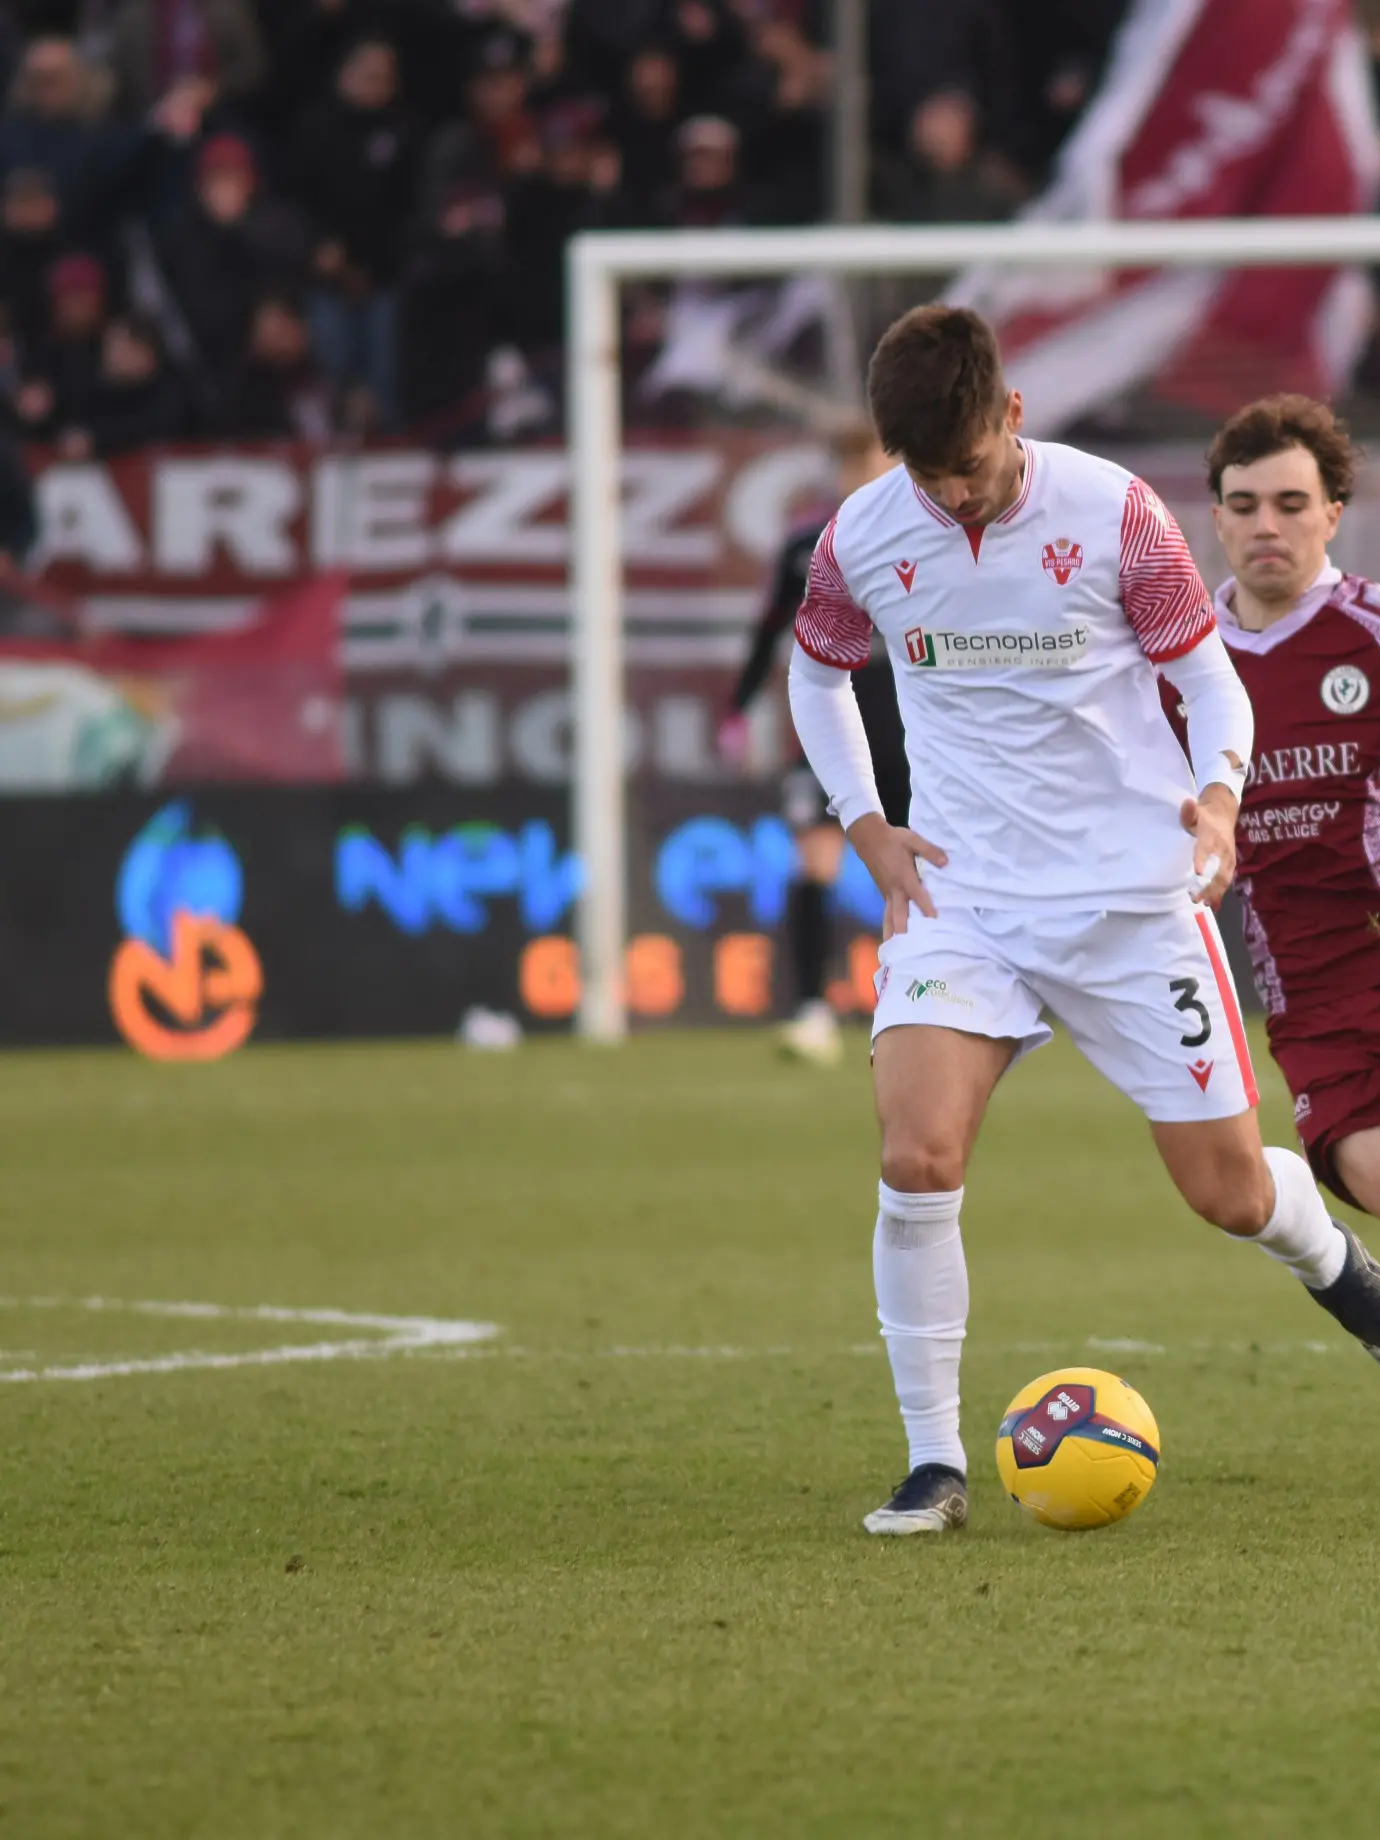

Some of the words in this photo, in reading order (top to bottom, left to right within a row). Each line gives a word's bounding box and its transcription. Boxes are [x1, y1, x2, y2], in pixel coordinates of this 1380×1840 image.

[937, 627, 1086, 653] Tecnoplast
[1248, 828, 1270, 843] GAS
[1274, 825, 1284, 840] E
[1285, 823, 1320, 839] LUCE
[925, 978, 947, 991] eco
[1168, 977, 1212, 1048] 3
[1026, 1426, 1046, 1443] NOW
[1102, 1427, 1121, 1439] NOW
[1126, 1437, 1142, 1448] SERIE
